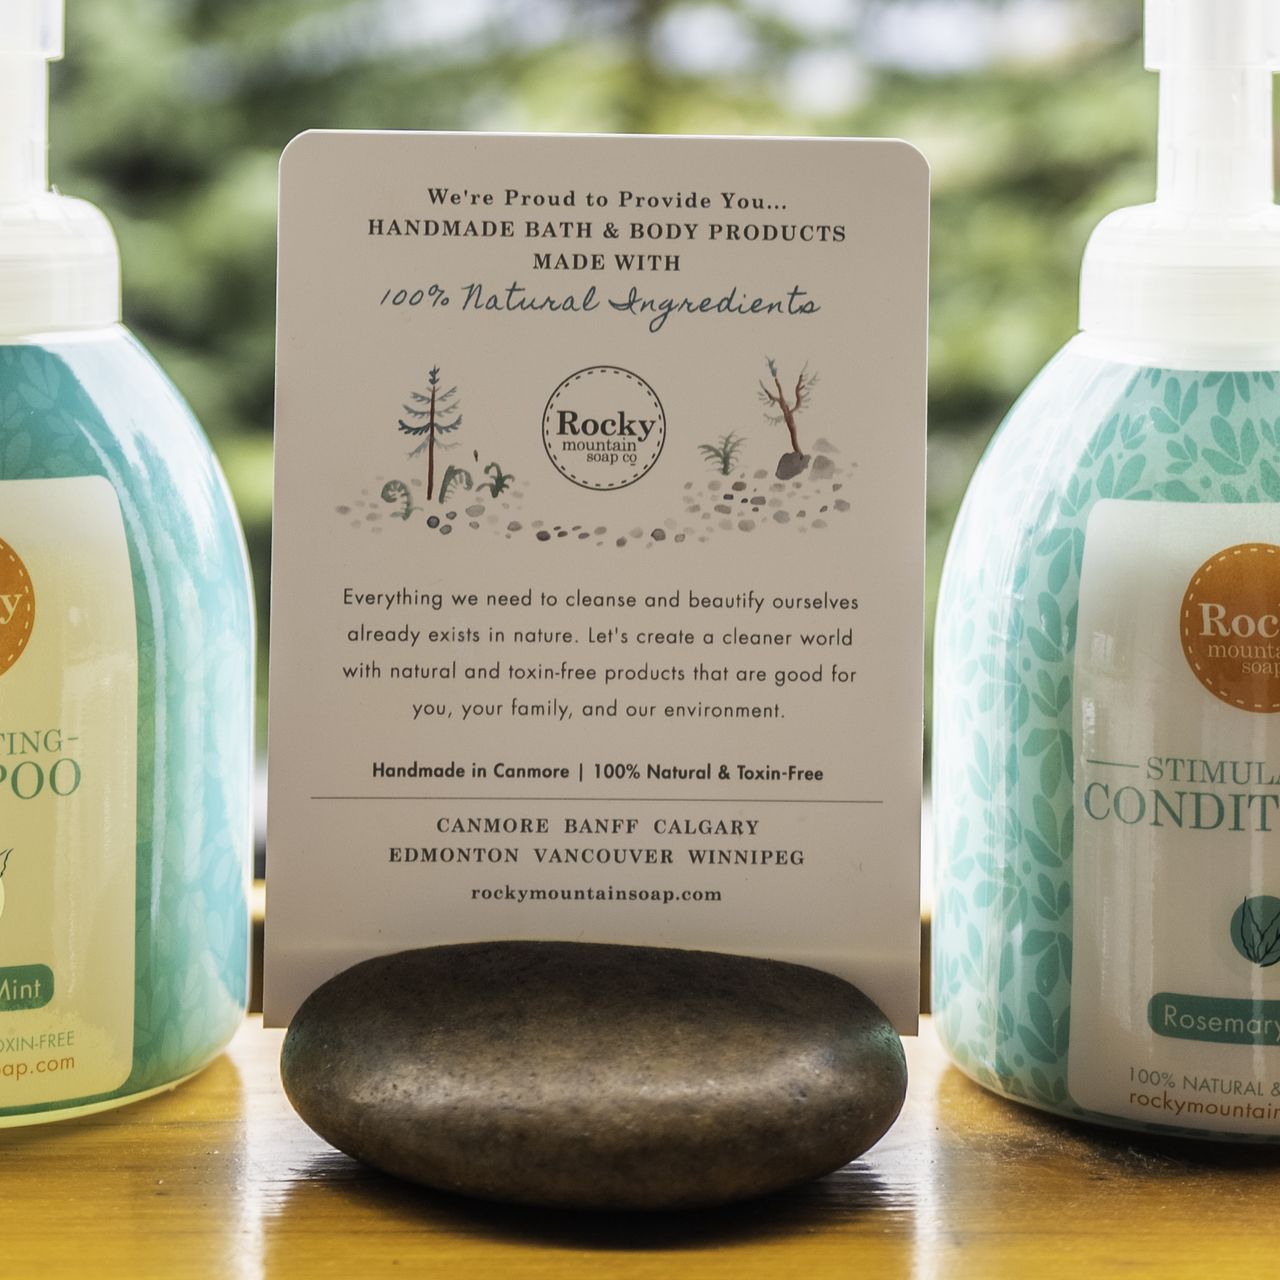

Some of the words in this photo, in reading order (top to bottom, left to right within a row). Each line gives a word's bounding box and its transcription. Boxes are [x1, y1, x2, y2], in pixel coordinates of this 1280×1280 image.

[427, 188, 494, 206] We're
[505, 189, 575, 207] Proud
[586, 192, 608, 208] to
[618, 190, 711, 209] Provide
[720, 192, 787, 210] You...
[368, 218, 515, 237] HANDMADE
[525, 221, 592, 239] BATH
[602, 222, 620, 239] &
[630, 222, 698, 240] BODY
[709, 223, 846, 242] PRODUCTS
[533, 253, 605, 271] MADE
[614, 254, 680, 272] WITH
[380, 283, 450, 308] 100%
[461, 280, 601, 312] Natural
[607, 284, 822, 334] Ingredients
[556, 410, 655, 442] Rocky
[562, 438, 636, 452] mountain
[586, 453, 619, 465] soap
[343, 587, 443, 611] Everything
[451, 594, 478, 607] we
[486, 588, 532, 607] need
[540, 592, 558, 607] to
[565, 588, 637, 608] cleanse
[644, 589, 680, 608] and
[689, 589, 765, 614] beautify
[772, 591, 859, 610] ourselves
[347, 623, 421, 648] already
[428, 626, 480, 643] exists
[489, 626, 505, 643] in
[514, 628, 579, 644] nature.
[588, 626, 628, 644] Let's
[636, 629, 695, 645] create
[702, 633, 714, 645] a
[722, 626, 792, 646] cleaner
[800, 627, 853, 647] world
[342, 659, 381, 679] with
[390, 660, 456, 679] natural
[464, 661, 500, 680] and
[508, 661, 597, 680] toxin-free
[605, 662, 685, 685] products
[693, 662, 729, 682] that
[736, 670, 767, 682] are
[774, 663, 823, 687] good
[831, 663, 857, 683] for
[412, 703, 452, 721] you,
[461, 704, 503, 721] your
[511, 697, 573, 721] family,
[582, 698, 618, 717] and
[625, 705, 657, 718] our
[664, 701, 785, 719] environment.
[372, 760, 466, 778] Handmade
[471, 762, 487, 778] in
[493, 762, 570, 779] Canmore
[594, 763, 641, 780] 100%
[647, 762, 711, 780] Natural
[717, 764, 731, 780] &
[736, 764, 824, 781] Toxin-Free
[436, 817, 549, 834] CANMORE
[564, 818, 639, 834] BANFF
[653, 819, 759, 836] CALGARY
[389, 847, 519, 863] EDMONTON
[533, 848, 674, 864] VANCOUVER
[688, 849, 804, 866] WINNIPEG
[471, 884, 722, 905] rockymountainsoap.com
[1129, 1067, 1177, 1089] 100%
[1182, 1074, 1266, 1095] NATURAL
